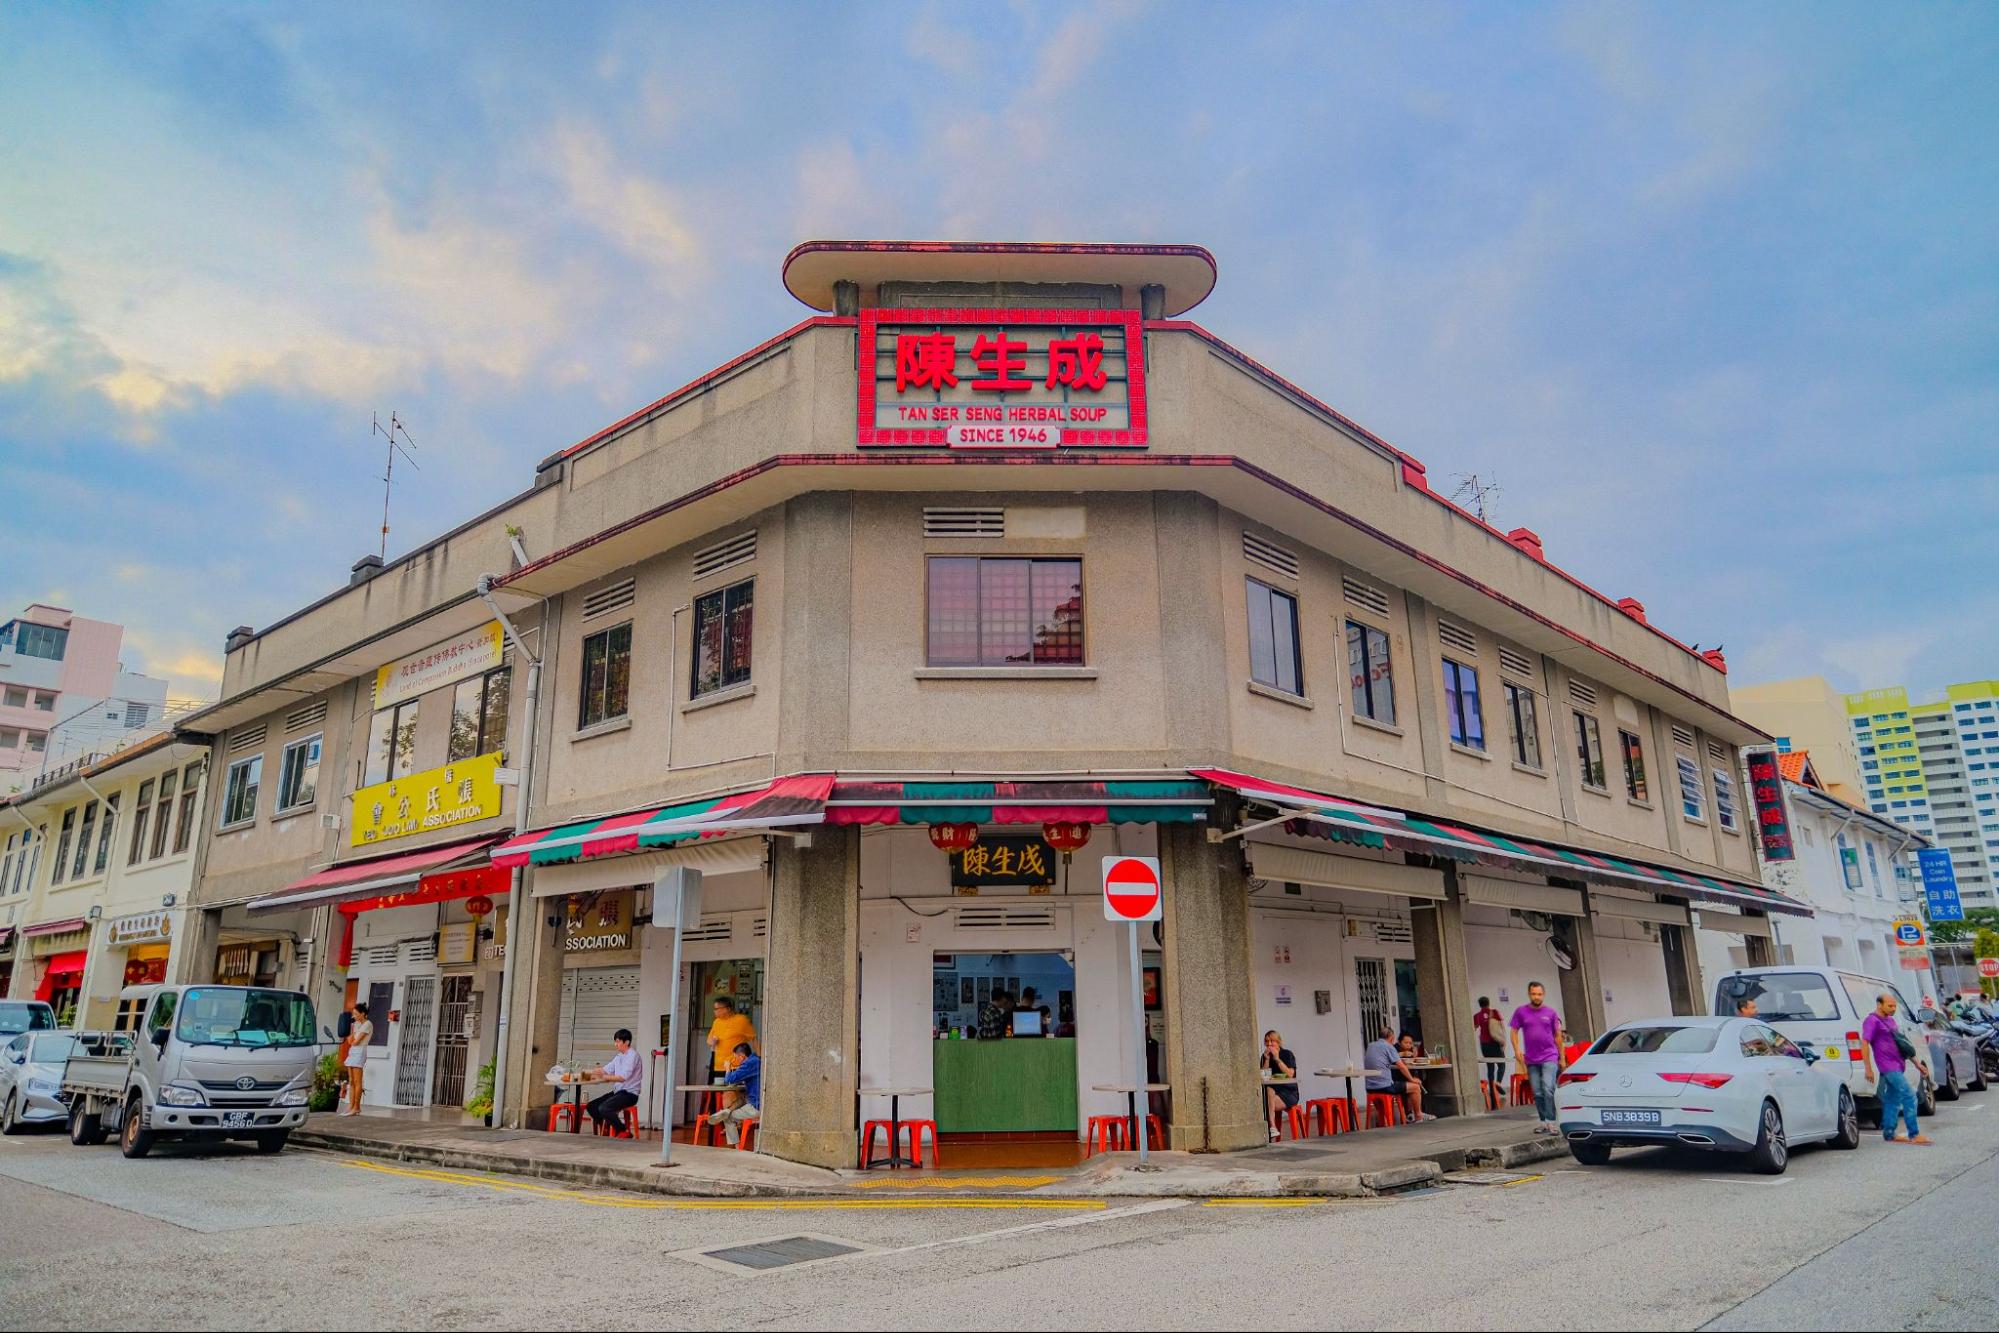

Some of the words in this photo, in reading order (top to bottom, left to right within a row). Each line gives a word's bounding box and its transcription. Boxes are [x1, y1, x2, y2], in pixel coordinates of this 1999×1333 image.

[896, 331, 1107, 393] 陳生成
[899, 406, 927, 421] TAN
[932, 407, 958, 421] SER
[966, 406, 1002, 421] SENG
[1009, 407, 1066, 422] HERBAL
[1070, 407, 1107, 422] SOUP
[960, 428, 1004, 443] SINCE
[1009, 428, 1047, 443] 1946
[423, 805, 483, 827] ASSOCIATION
[565, 934, 627, 950] SSOCIATION
[1980, 963, 1999, 972] STOP
[229, 1112, 248, 1120] GBF
